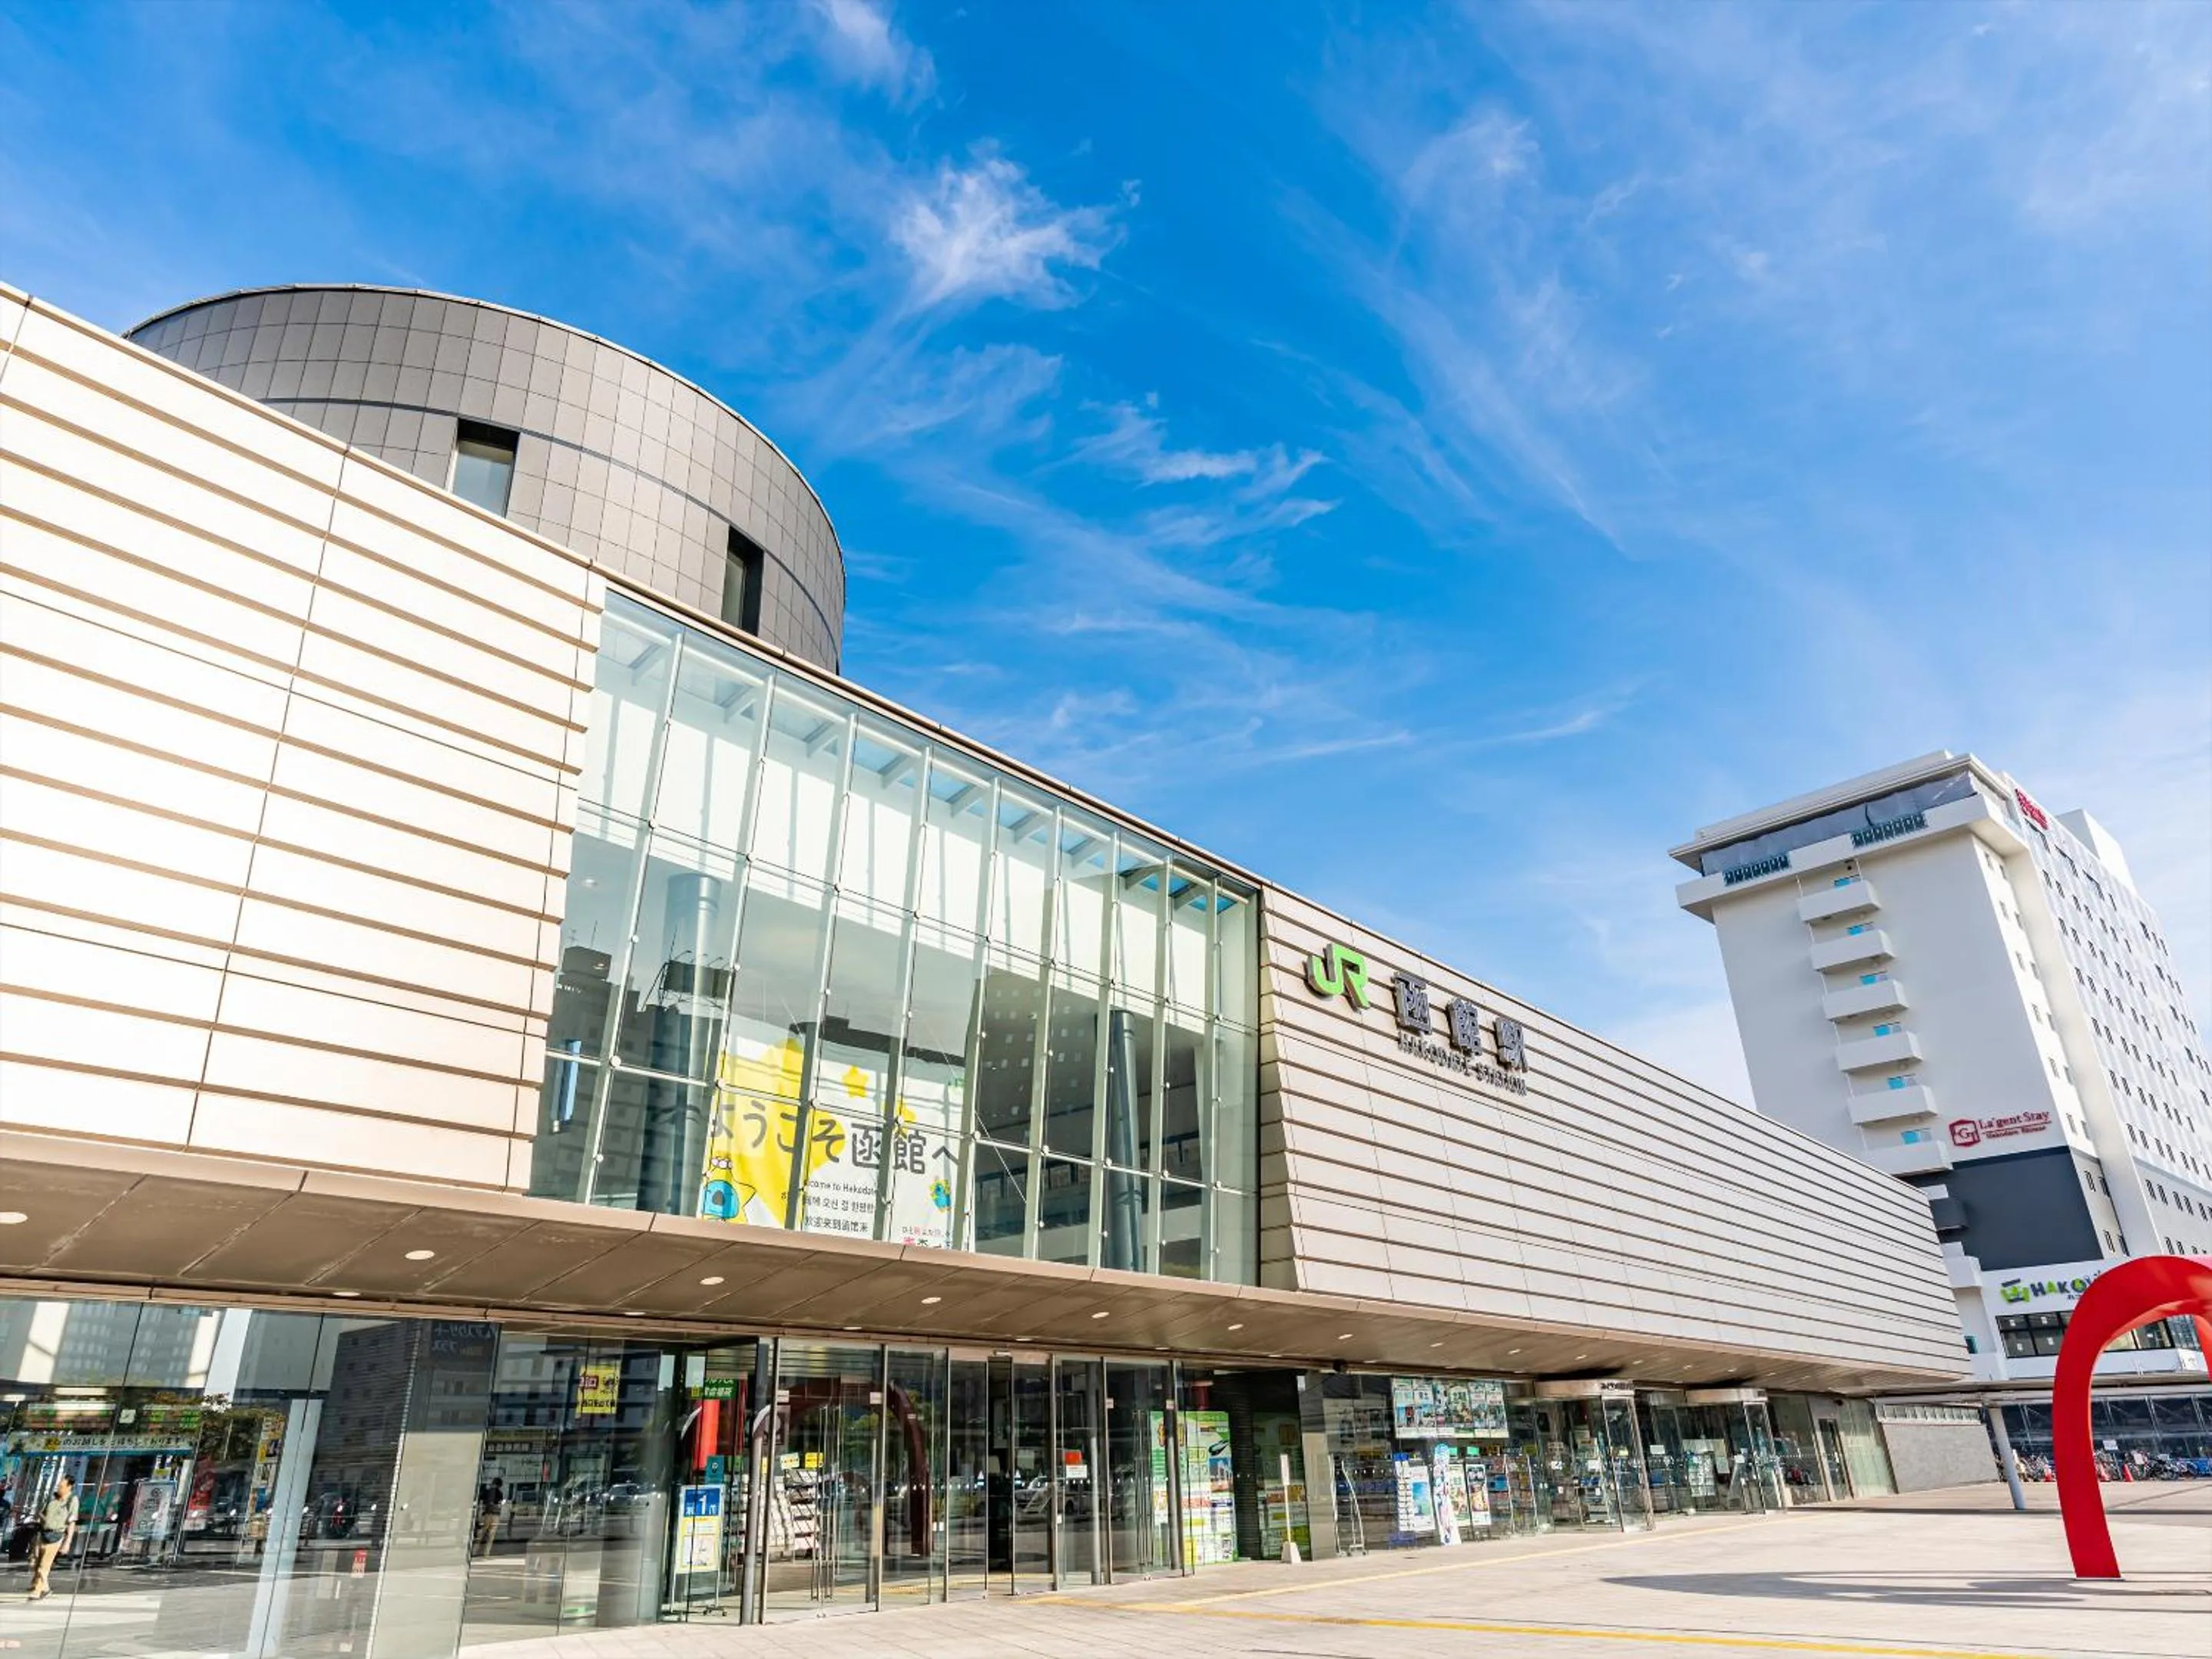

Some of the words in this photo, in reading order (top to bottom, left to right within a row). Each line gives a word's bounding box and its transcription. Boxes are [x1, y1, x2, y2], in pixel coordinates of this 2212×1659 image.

[1306, 942, 1371, 1012] JR
[1391, 971, 1528, 1073] 函館駅
[710, 1101, 959, 1175] ようこそ函館へ
[1978, 1114, 2023, 1130] La'gent
[2024, 1111, 2050, 1123] Stay
[843, 1183, 875, 1196] Hakodat
